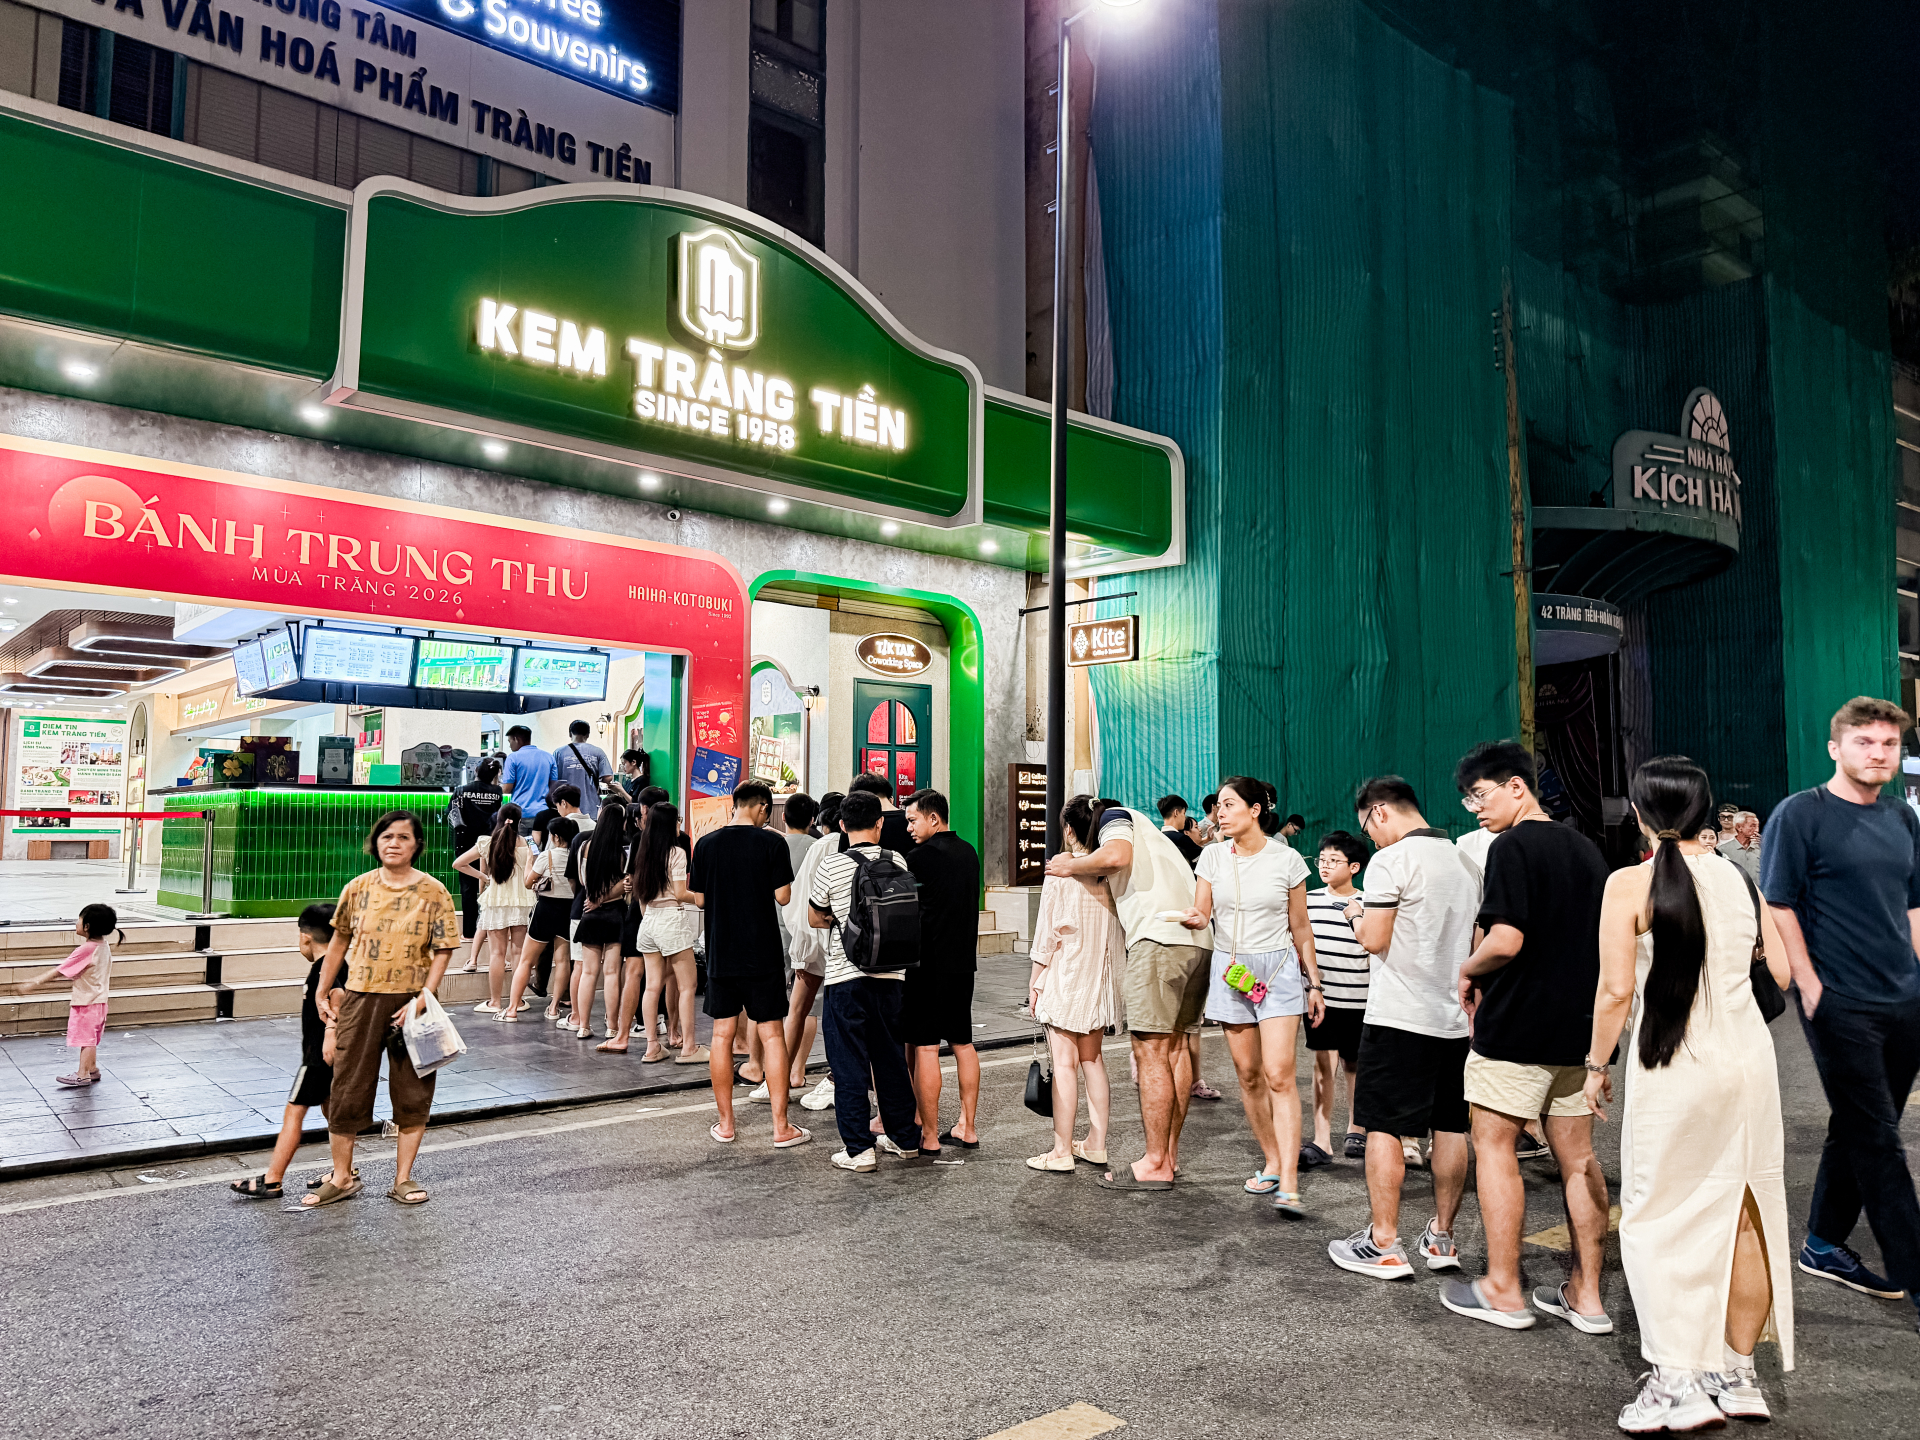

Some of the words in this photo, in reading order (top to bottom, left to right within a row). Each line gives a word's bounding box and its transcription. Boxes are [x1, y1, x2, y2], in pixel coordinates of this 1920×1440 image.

[351, 9, 417, 59] TÂM
[485, 0, 649, 91] Souvenirs
[260, 25, 341, 86] HOÁ
[353, 58, 459, 126] PHẨM
[471, 99, 576, 166] TRÀNG
[479, 298, 607, 376] KEM
[627, 339, 797, 423] TRÀNG
[811, 383, 906, 450] TIỀN
[634, 390, 730, 435] SINCE
[737, 413, 797, 450] 1958
[1687, 446, 1714, 471] NHÀ
[82, 495, 266, 560] BÁNH
[287, 529, 474, 586] TRUNG
[491, 557, 590, 601] THU
[252, 566, 303, 586] MÙA
[317, 574, 396, 597] TRĂNG
[408, 585, 463, 605] 2026
[628, 585, 733, 612] HAIHA-KOTOBUKI
[1541, 605, 1553, 619] 42
[1556, 602, 1582, 622] TRÀNG
[1091, 627, 1126, 649] Kite
[867, 654, 903, 669] Coworking
[903, 658, 924, 671] Space
